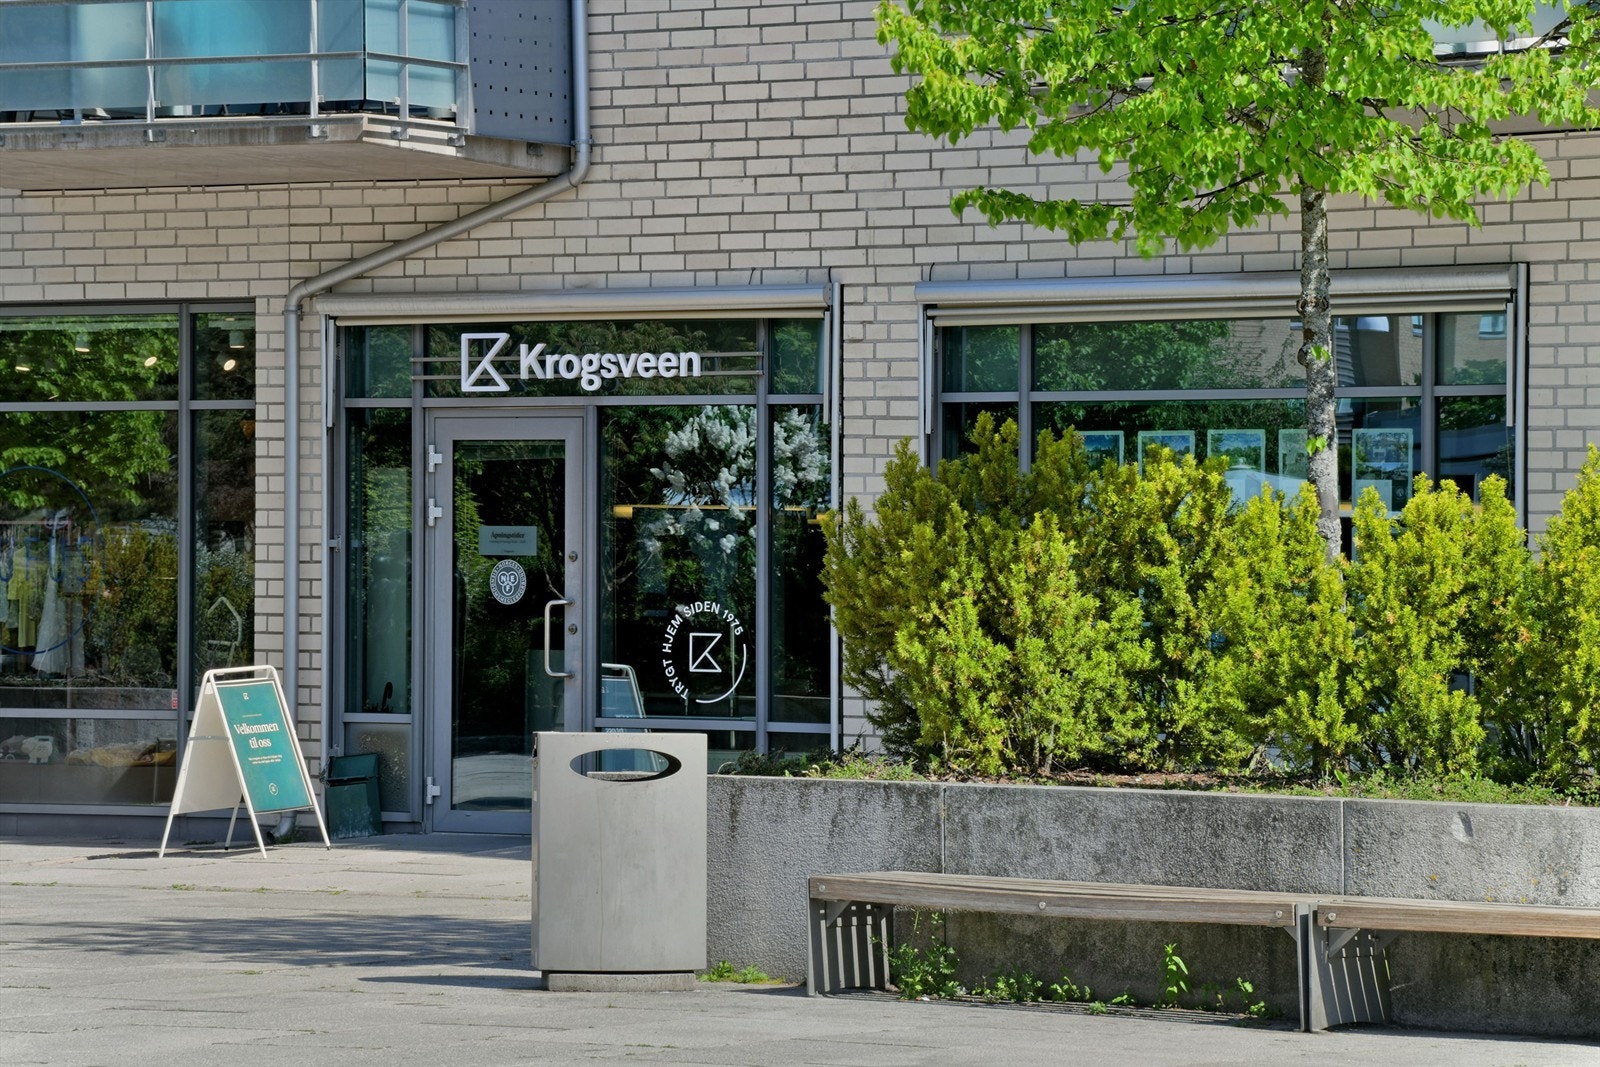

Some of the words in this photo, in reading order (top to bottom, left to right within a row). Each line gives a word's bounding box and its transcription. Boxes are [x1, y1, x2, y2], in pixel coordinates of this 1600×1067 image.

[520, 343, 701, 391] Krogsveen
[683, 601, 721, 617] SIDEN
[722, 609, 744, 636] 1975
[662, 614, 683, 653] HJEM
[662, 659, 689, 700] TRYGT
[234, 723, 279, 735] Velkommen
[249, 737, 258, 749] til
[259, 738, 272, 748] oss
